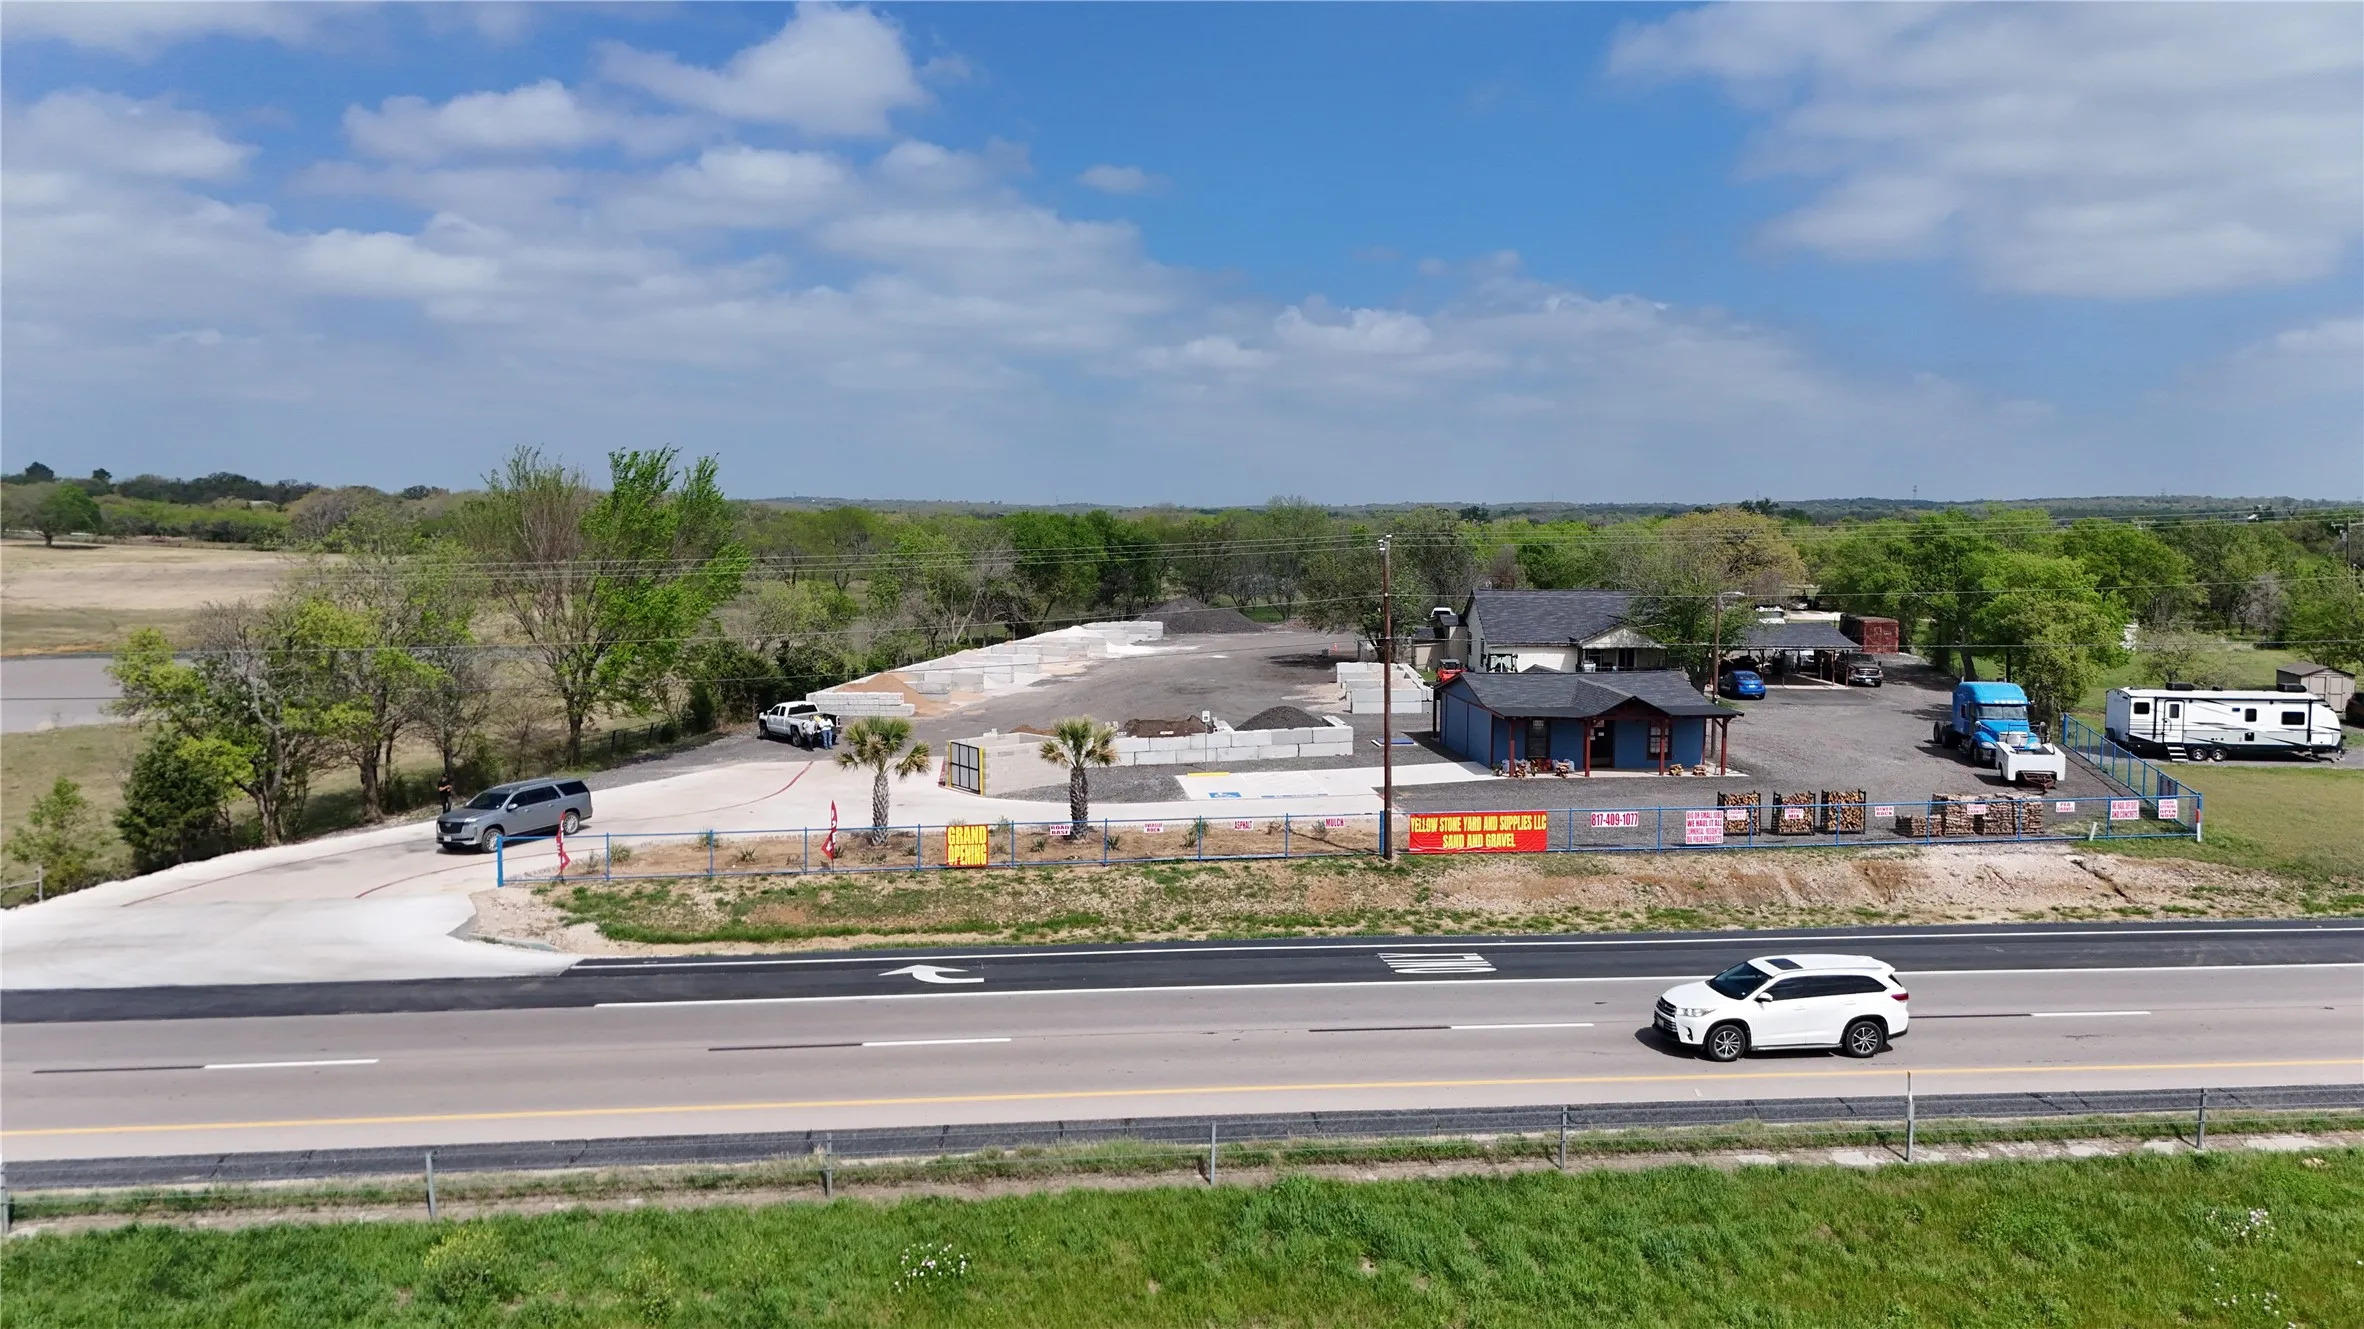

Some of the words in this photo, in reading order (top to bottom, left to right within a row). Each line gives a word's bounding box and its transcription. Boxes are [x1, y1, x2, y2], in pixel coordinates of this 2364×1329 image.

[1591, 813, 1638, 826] 817-409-1077
[1686, 811, 1694, 820] BIG
[1700, 811, 1713, 819] SMALL
[1235, 820, 1253, 830] ASPHALT
[1325, 818, 1344, 827] MULCH
[1410, 817, 1438, 832] YELLOW
[1439, 816, 1461, 832] STONE
[1463, 816, 1482, 832] YARD
[1483, 815, 1498, 831] AND
[1499, 815, 1532, 831] SUPPLIES
[1533, 814, 1547, 830] LLC
[1686, 820, 1695, 828] WE
[1708, 819, 1714, 827] IT
[1714, 819, 1723, 827] ALL
[947, 826, 987, 845] GRAND
[1443, 834, 1464, 849] SAND
[1467, 834, 1483, 848] AND
[1485, 833, 1516, 847] GRAVEL
[1704, 835, 1723, 843] PROJECTS
[947, 844, 987, 865] OPENING
